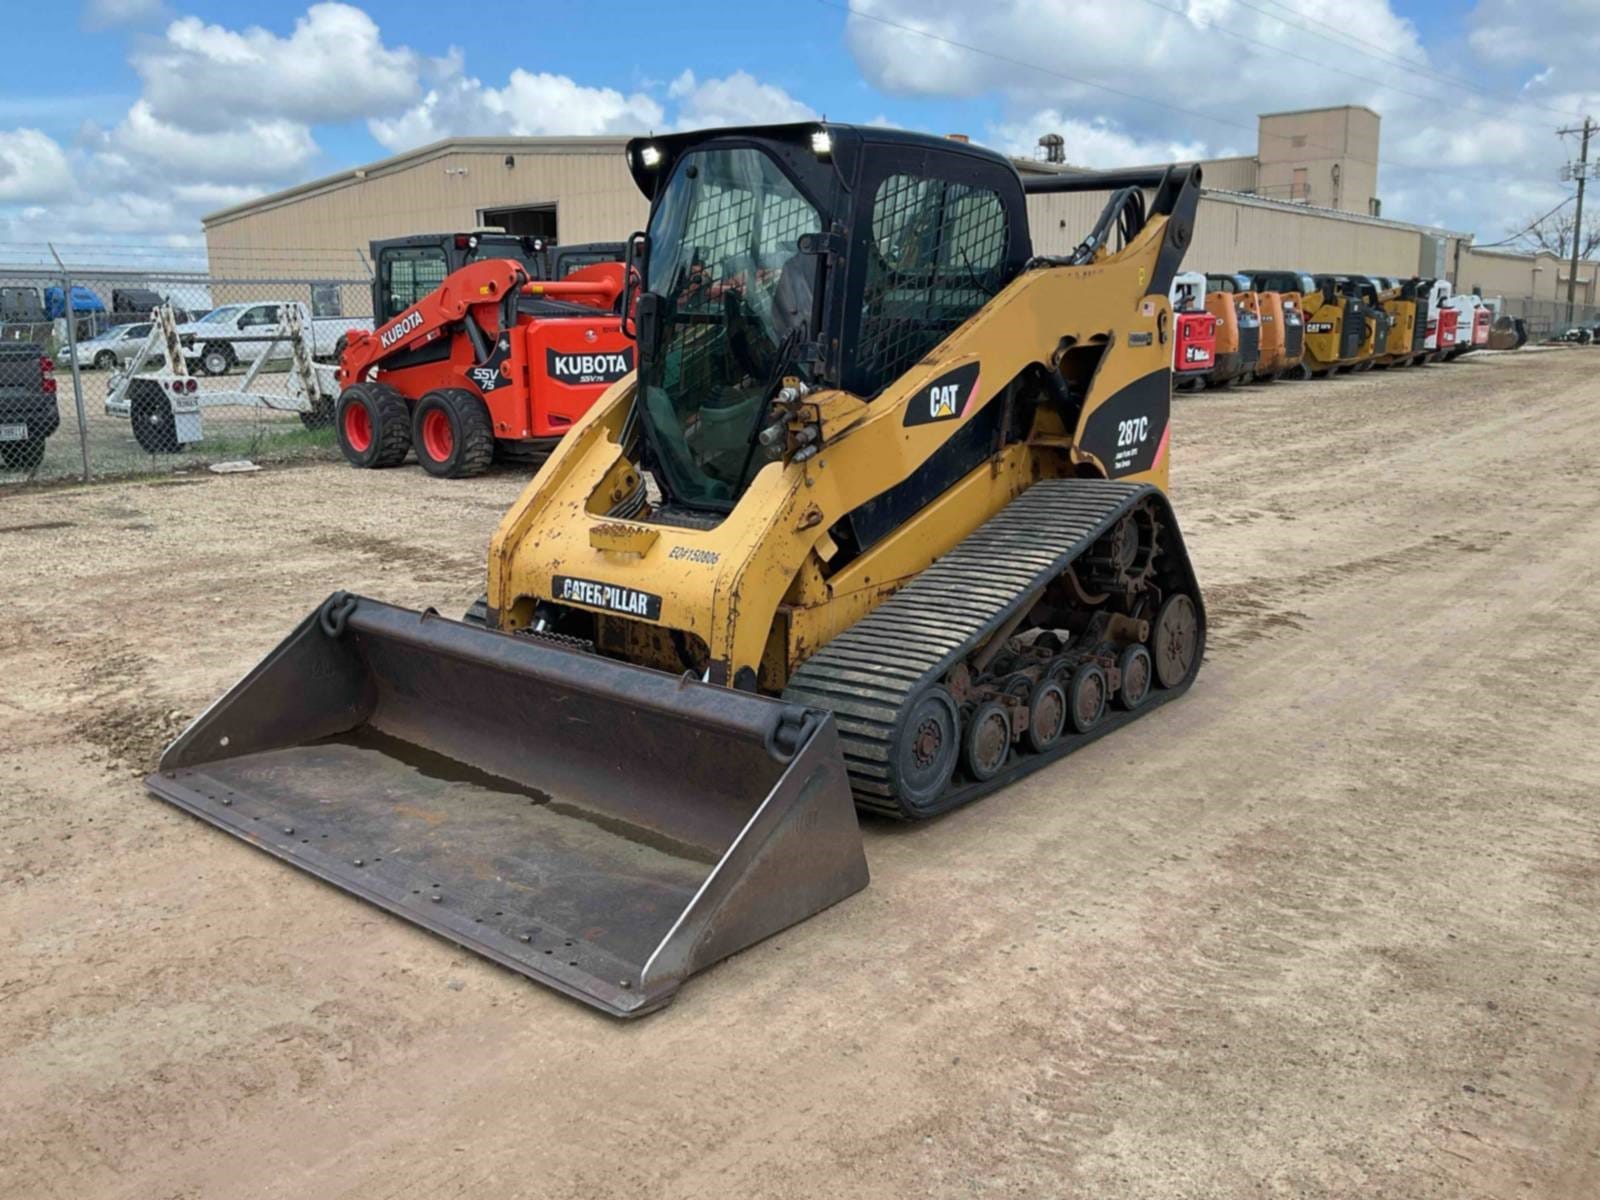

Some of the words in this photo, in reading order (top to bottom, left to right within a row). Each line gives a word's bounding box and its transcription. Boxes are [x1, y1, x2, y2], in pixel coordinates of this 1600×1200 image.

[381, 311, 423, 348] KUBOTA
[1306, 324, 1320, 333] CAT
[473, 368, 499, 380] SSV
[555, 355, 627, 375] KUBOTA
[481, 380, 495, 389] 75
[930, 384, 959, 418] CAT
[1117, 416, 1148, 447] 287C
[563, 578, 648, 615] CATERPILLAR
